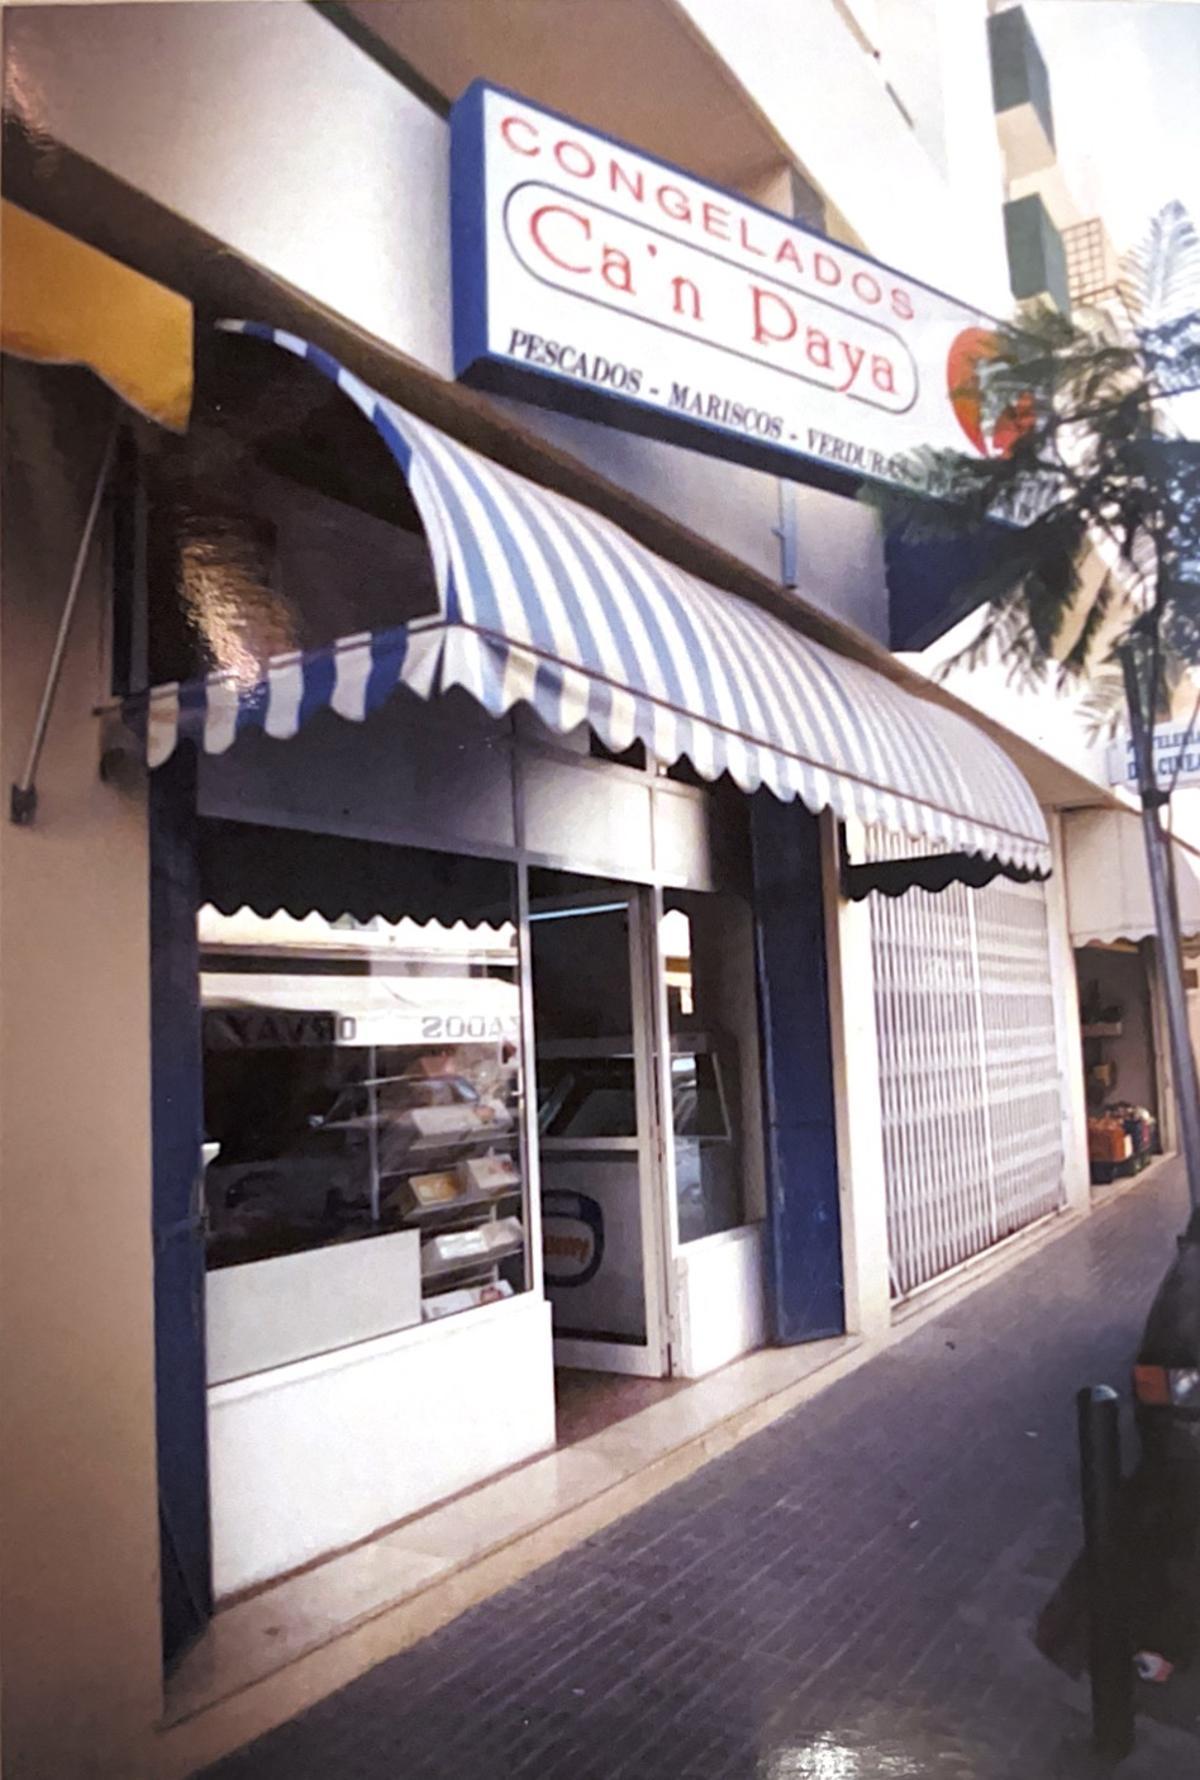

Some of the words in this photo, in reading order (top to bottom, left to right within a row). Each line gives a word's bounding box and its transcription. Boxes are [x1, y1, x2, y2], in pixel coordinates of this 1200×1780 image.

[501, 116, 914, 320] CONGELADOS
[529, 205, 705, 322] Ca'n
[749, 284, 897, 393] Paya
[508, 328, 643, 394] PESCADOS
[668, 381, 784, 438] MARISCOS
